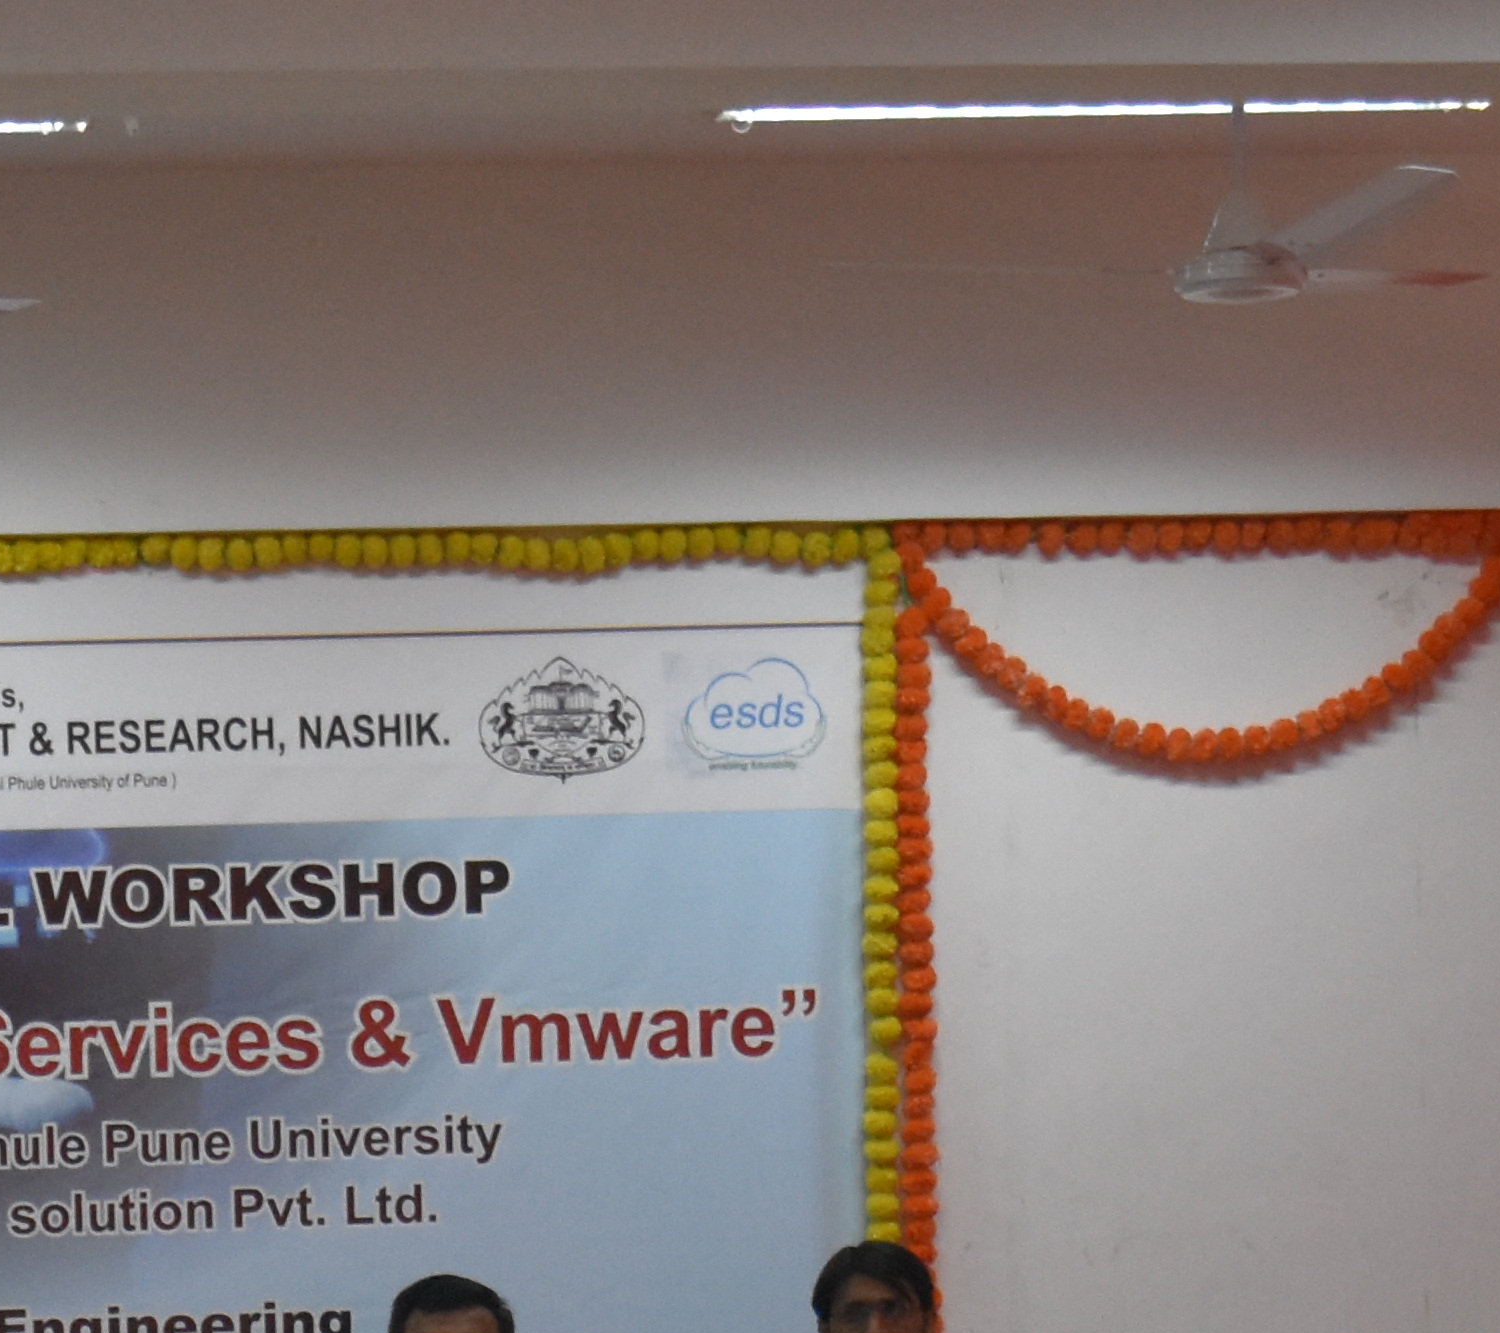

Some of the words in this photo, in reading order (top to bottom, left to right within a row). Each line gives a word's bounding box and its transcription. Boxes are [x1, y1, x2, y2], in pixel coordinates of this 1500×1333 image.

[28, 721, 56, 757] &
[65, 714, 288, 757] RESEARCH,
[299, 711, 452, 750] NASHIK.
[709, 693, 806, 730] esds
[8, 776, 45, 792] Phule
[49, 774, 113, 793] University
[117, 773, 130, 789] of
[36, 859, 512, 931] WORKSHOP
[349, 1001, 410, 1068] &
[104, 1121, 231, 1166] Pune
[249, 1113, 502, 1166] University
[10, 1189, 216, 1236] solution
[232, 1188, 327, 1230] Pvt.
[345, 1183, 439, 1227] Ltd.
